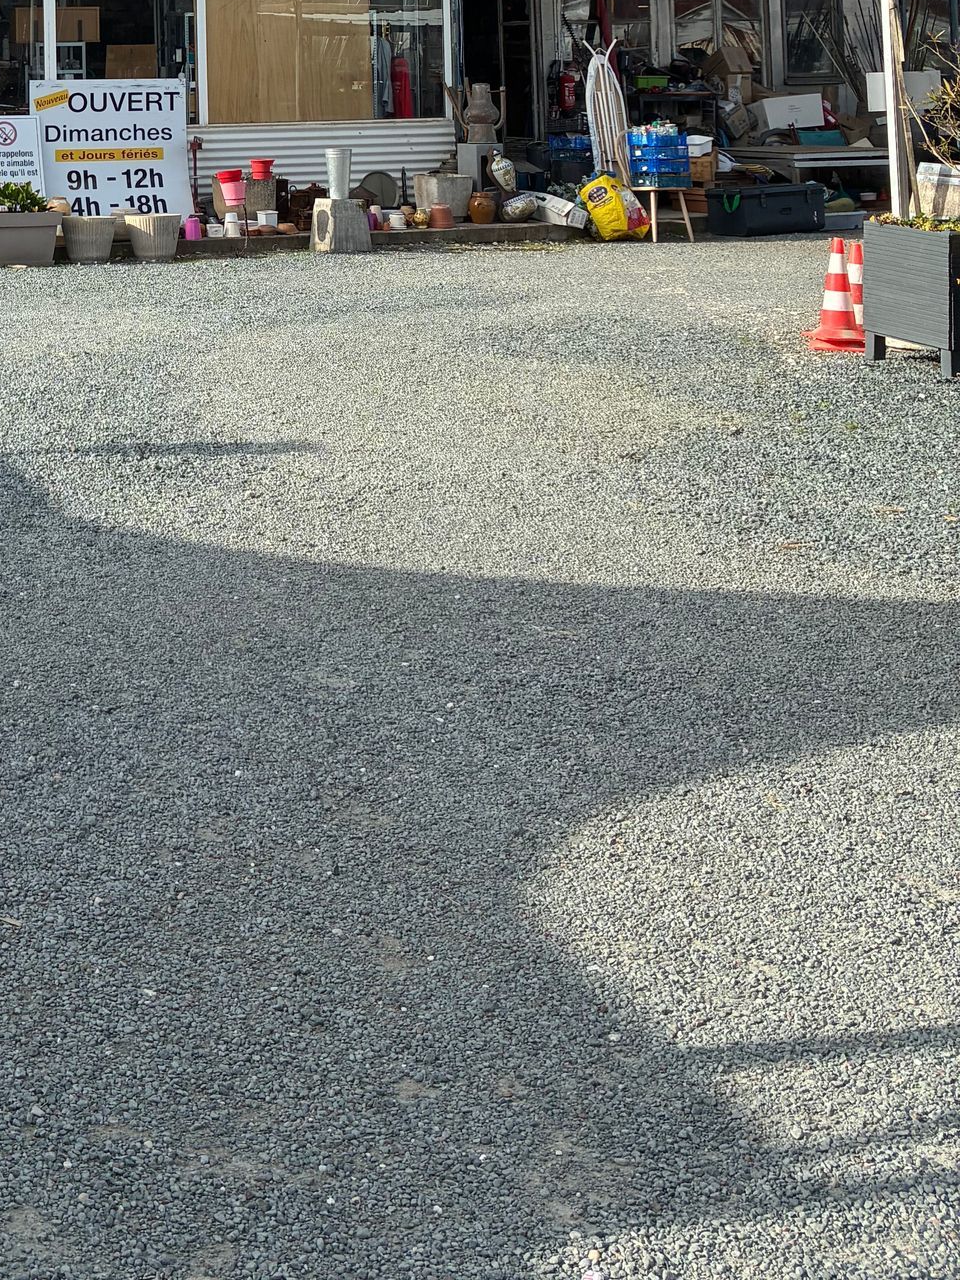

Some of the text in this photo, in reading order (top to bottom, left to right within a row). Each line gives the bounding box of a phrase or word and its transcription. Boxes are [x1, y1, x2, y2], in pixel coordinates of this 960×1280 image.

[35, 93, 69, 109] Nouveau
[67, 91, 180, 113] OUVERT
[44, 124, 173, 143] Dimanches
[61, 148, 158, 160] et Jours fériés
[6, 159, 35, 167] aimable
[9, 169, 26, 178] qu'il
[26, 168, 38, 176] est
[67, 170, 98, 190] 9h
[122, 168, 164, 189] 12h
[71, 196, 101, 217] 4h
[125, 194, 168, 215] 18h
